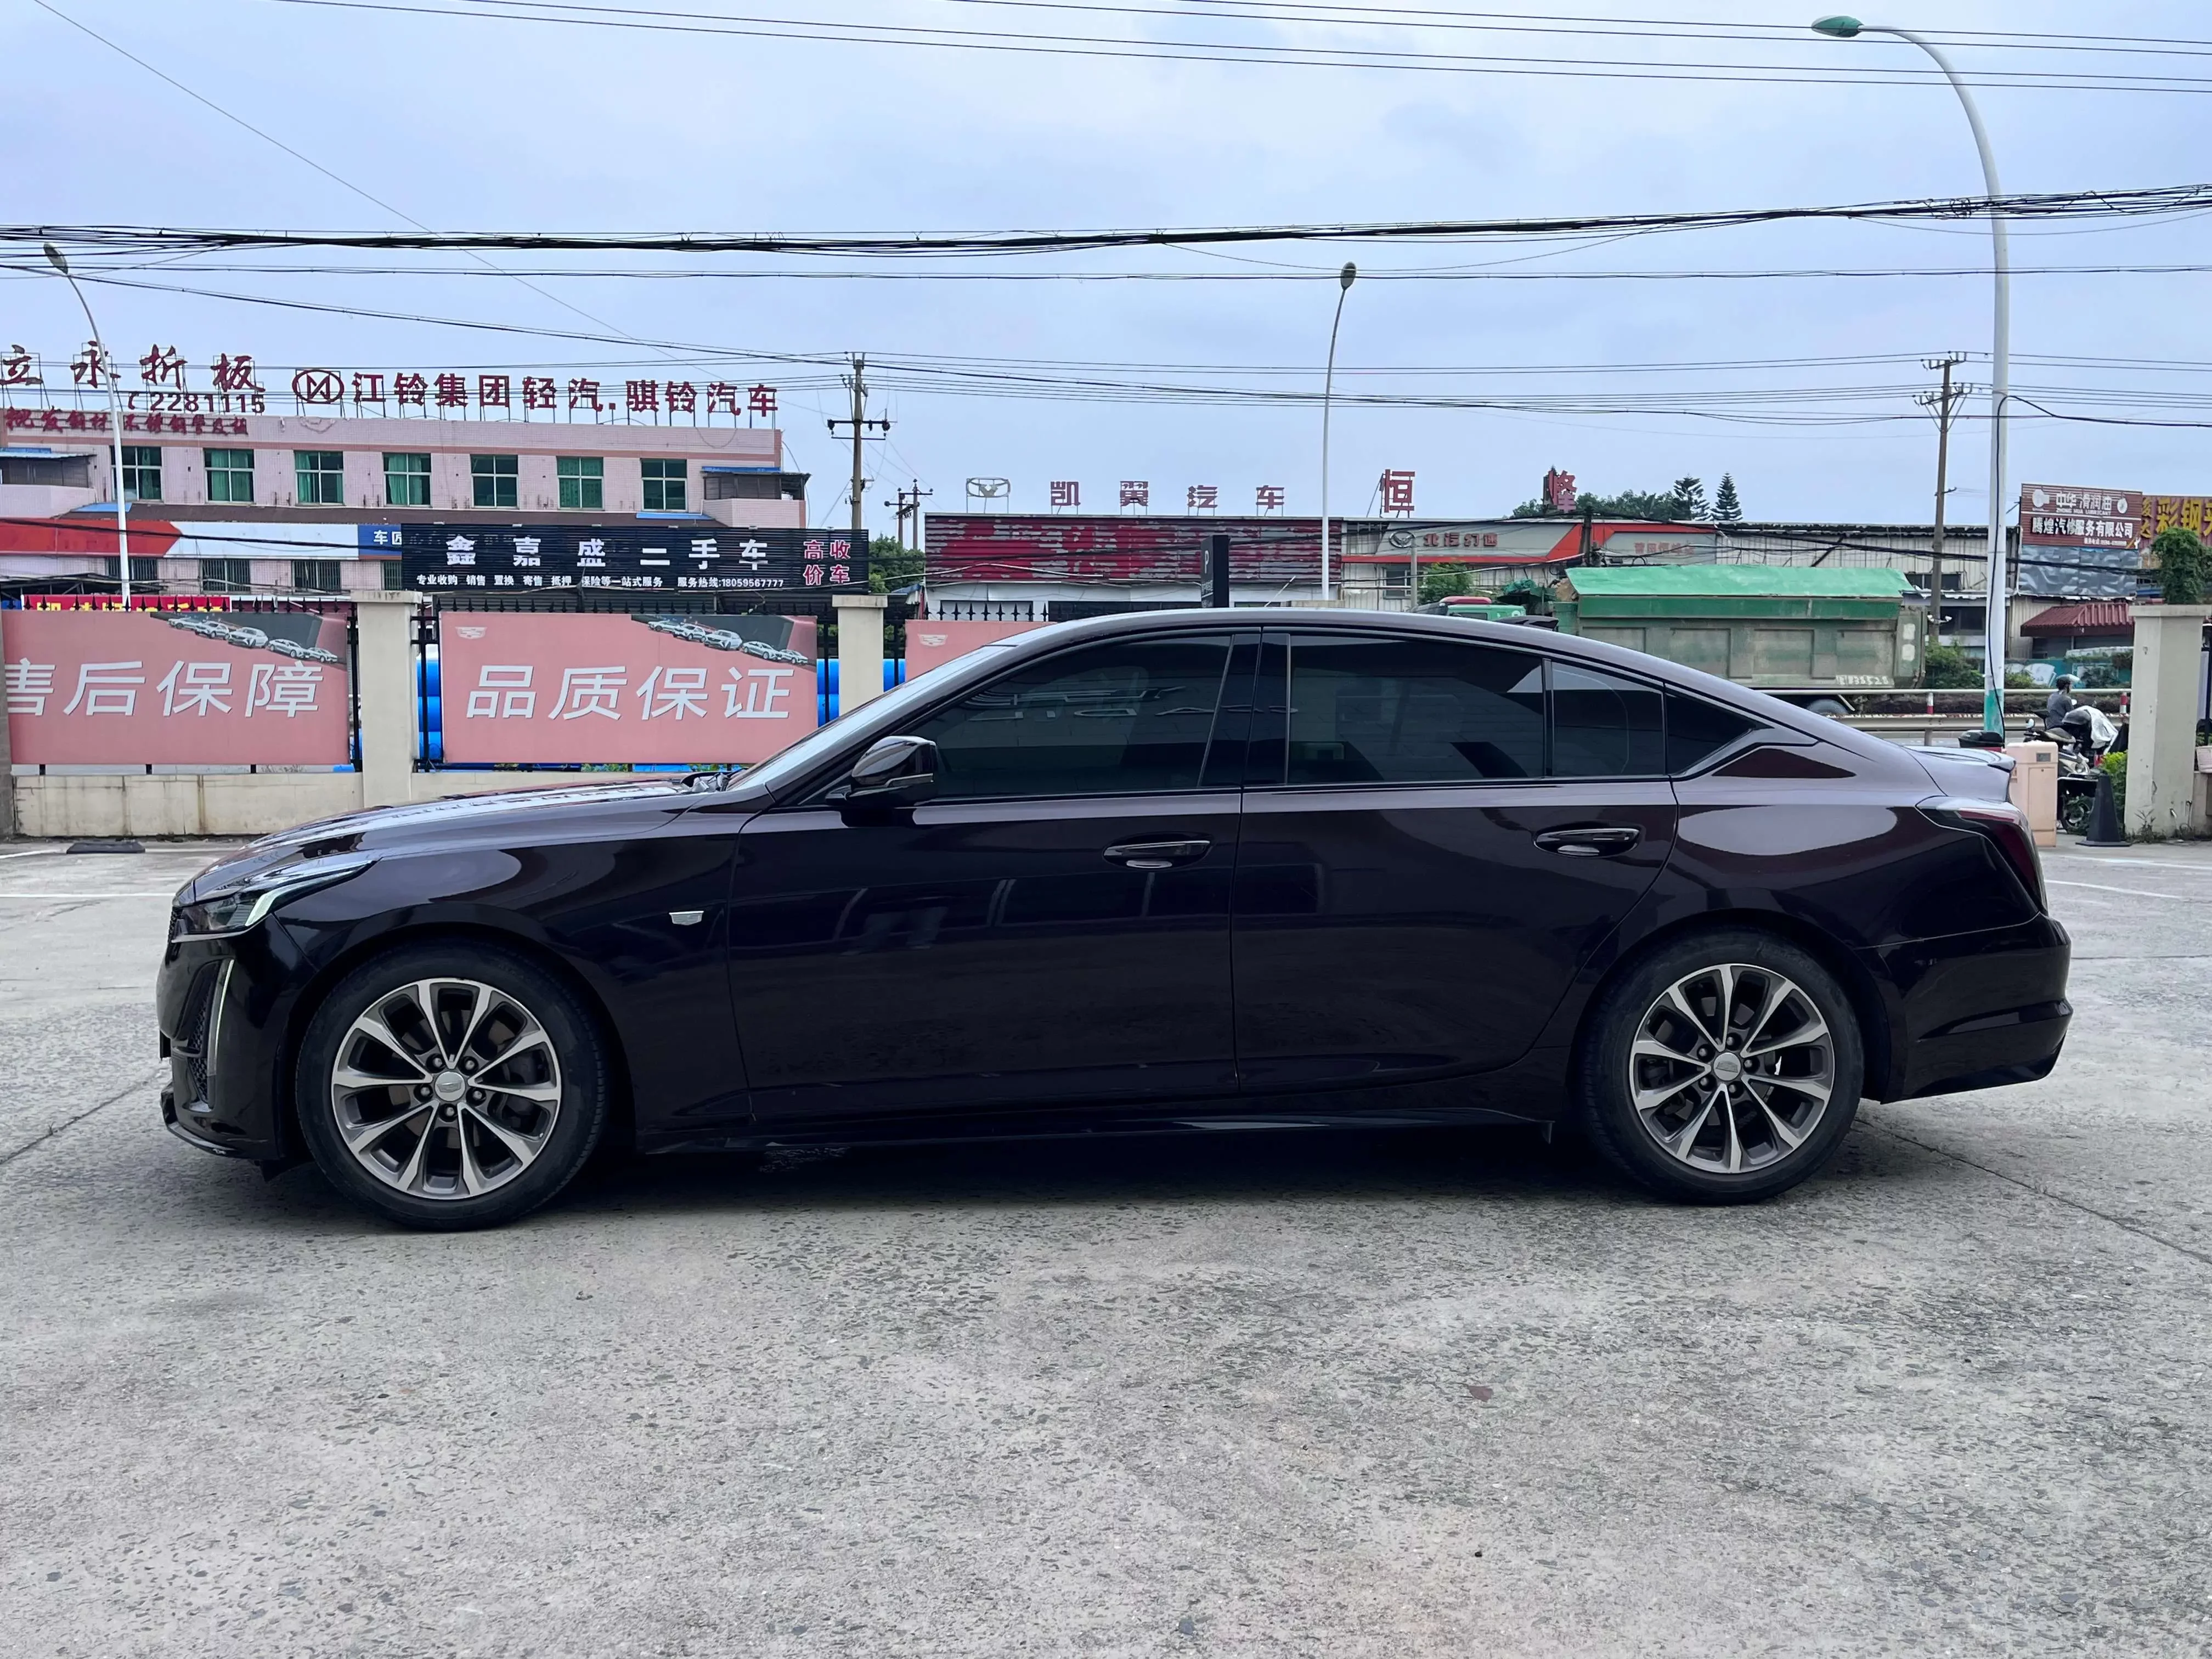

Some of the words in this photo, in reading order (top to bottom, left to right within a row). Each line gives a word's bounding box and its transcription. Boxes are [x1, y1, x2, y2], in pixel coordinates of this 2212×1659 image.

[150, 393, 265, 413] 2281115
[1051, 481, 1285, 509] 凯翼汽车
[446, 535, 768, 571] 鑫嘉盛二手车
[416, 574, 458, 585] 专业收购
[466, 575, 486, 586] 销售
[494, 575, 514, 586] 置换
[582, 576, 663, 588] 保险等一站式服务
[466, 665, 795, 720] 品质保证
